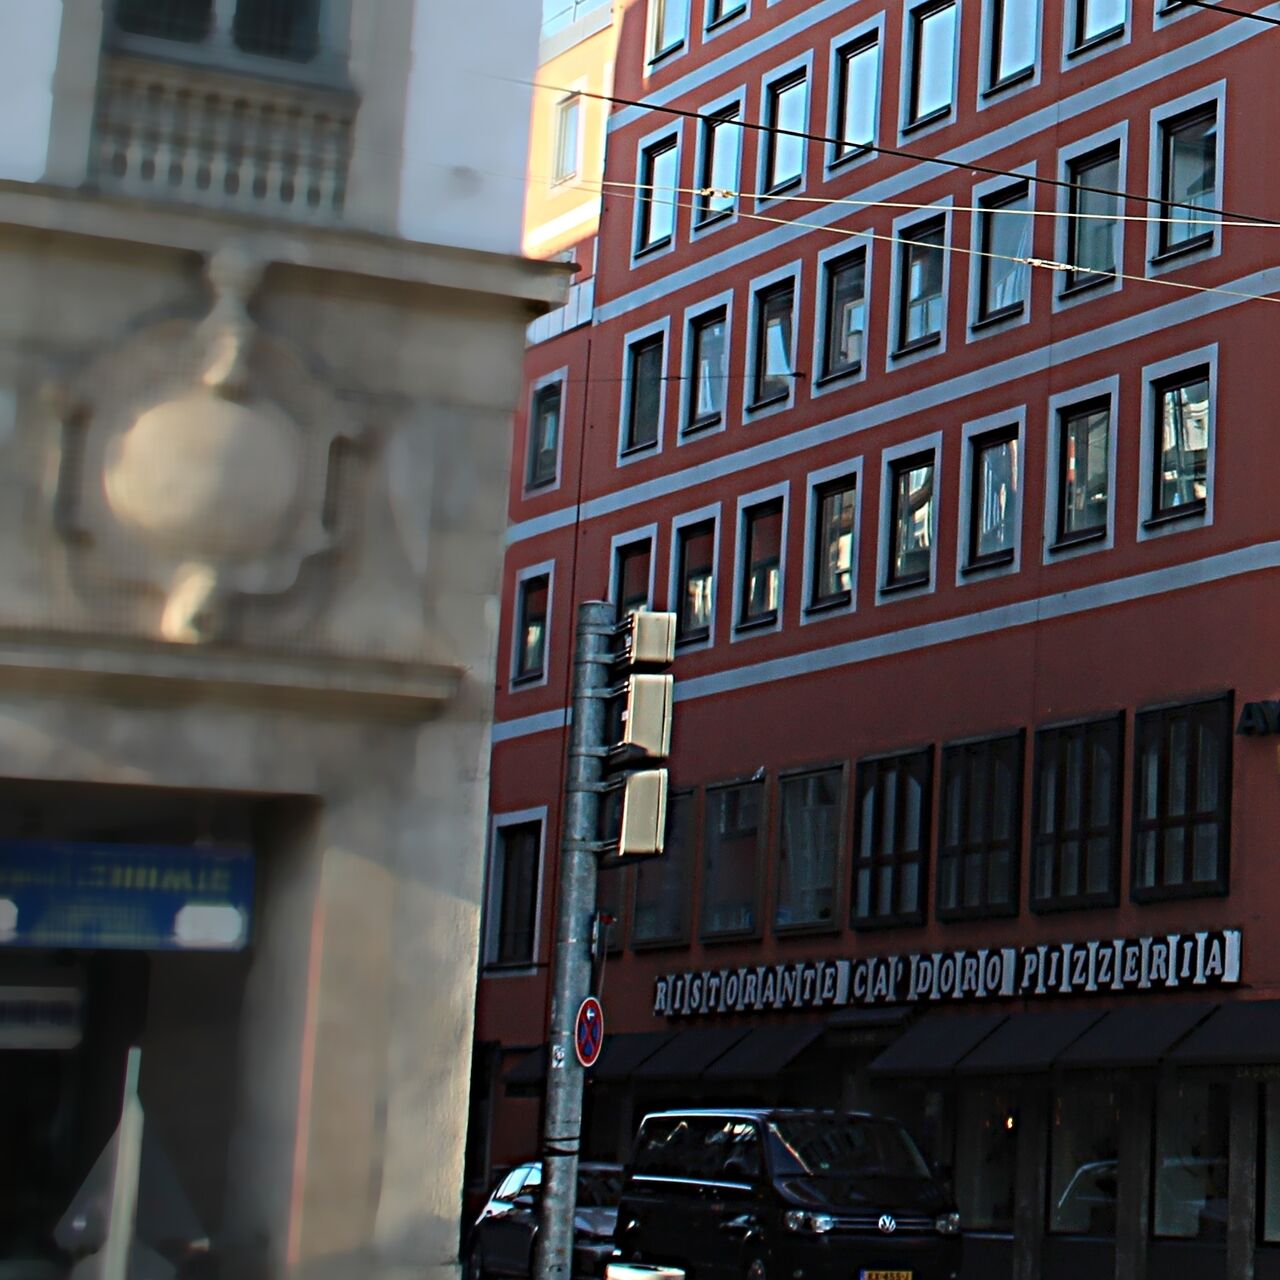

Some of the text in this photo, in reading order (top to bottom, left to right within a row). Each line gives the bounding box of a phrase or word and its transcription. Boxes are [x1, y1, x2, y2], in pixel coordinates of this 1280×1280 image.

[654, 966, 836, 1011] RISTORANTE
[916, 952, 1001, 995] DORO
[1020, 937, 1223, 988] PIZZERIA
